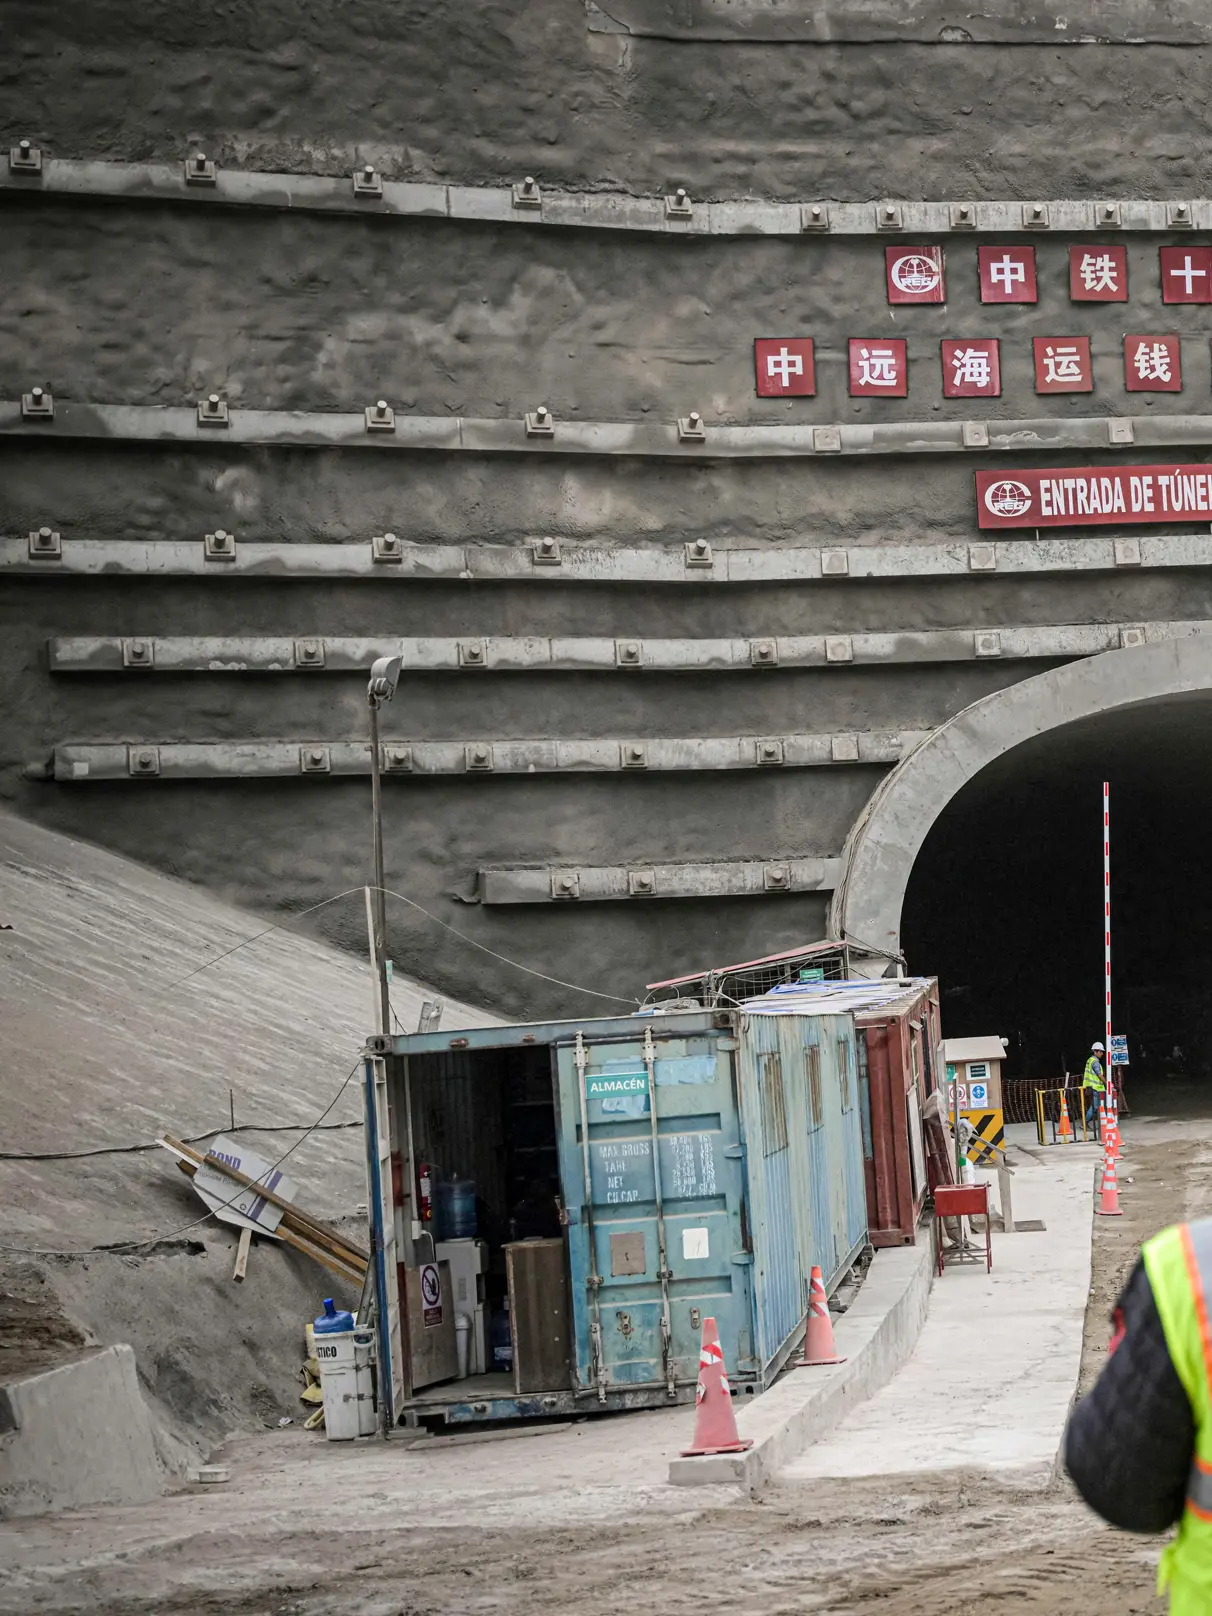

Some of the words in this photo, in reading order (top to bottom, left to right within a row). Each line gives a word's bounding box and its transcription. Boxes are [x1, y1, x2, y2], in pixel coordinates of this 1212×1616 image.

[1040, 477, 1124, 516] ENTRADA
[1130, 476, 1154, 513] DE
[590, 1078, 645, 1092] ALMACÉN
[608, 1175, 624, 1189] NET
